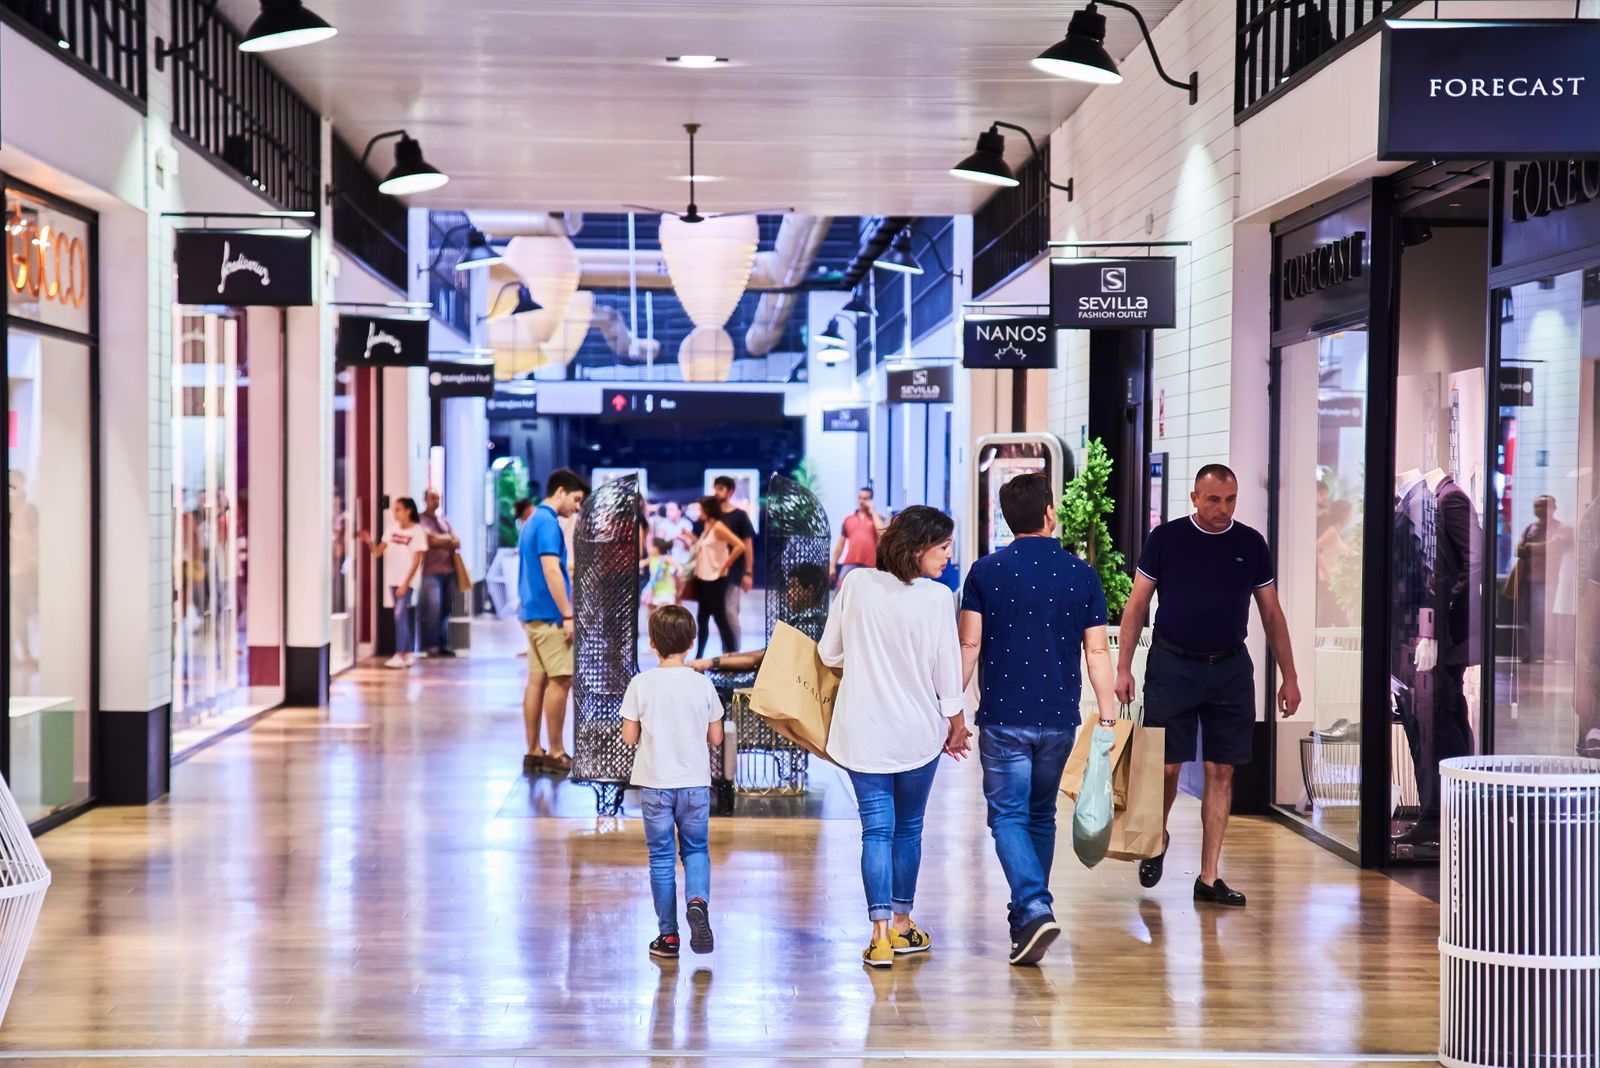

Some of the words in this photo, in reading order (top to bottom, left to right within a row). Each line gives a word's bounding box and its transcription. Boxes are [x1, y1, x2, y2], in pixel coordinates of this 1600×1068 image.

[1429, 77, 1585, 97] FORECAST
[1282, 232, 1366, 300] FORECAST
[1078, 311, 1115, 319] FASHION
[1117, 311, 1148, 319] OUTLET
[976, 325, 1047, 343] NANOS
